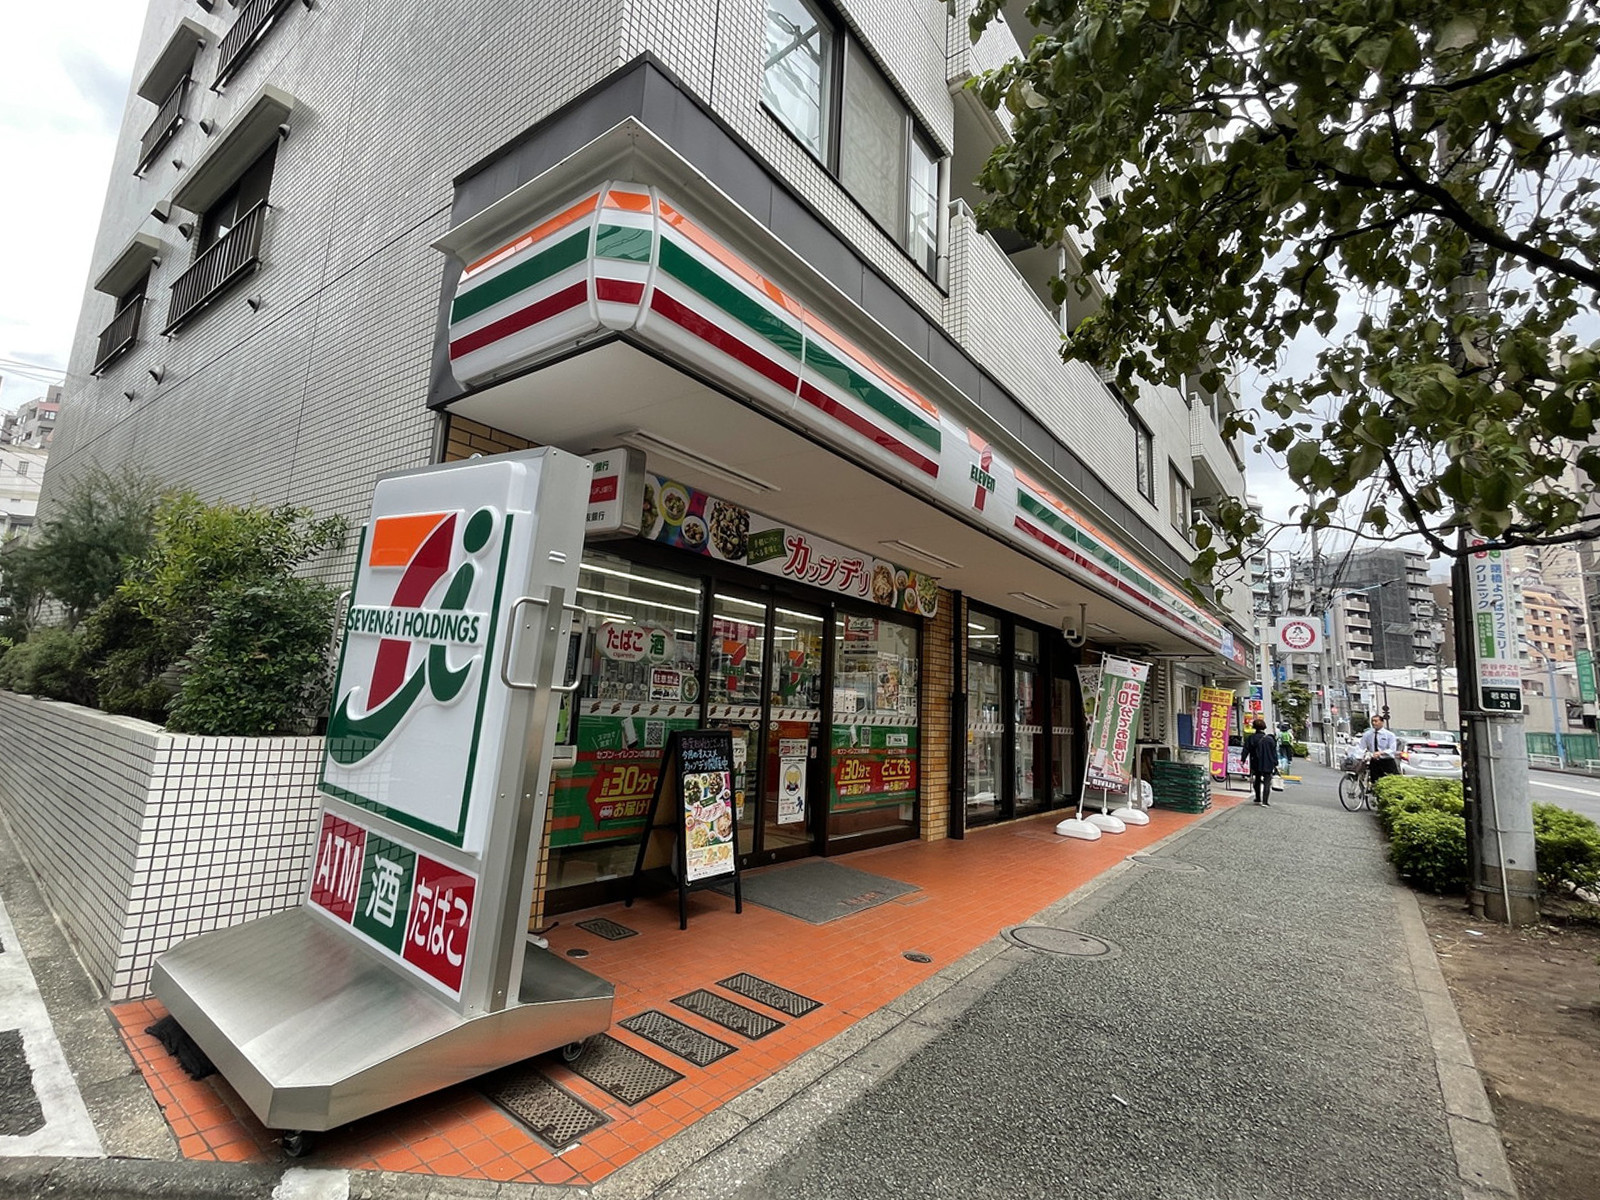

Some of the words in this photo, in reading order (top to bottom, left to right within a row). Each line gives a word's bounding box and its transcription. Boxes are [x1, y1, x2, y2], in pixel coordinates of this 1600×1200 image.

[783, 536, 870, 597] カップデリ
[1474, 564, 1489, 609] クリニック
[402, 611, 480, 644] HOLDINGS
[606, 627, 643, 652] たばこ
[650, 633, 666, 656] 酒
[882, 758, 911, 776] どこでも
[316, 832, 361, 904] ATM
[365, 853, 404, 928] 酒
[408, 876, 469, 967] たばこ
